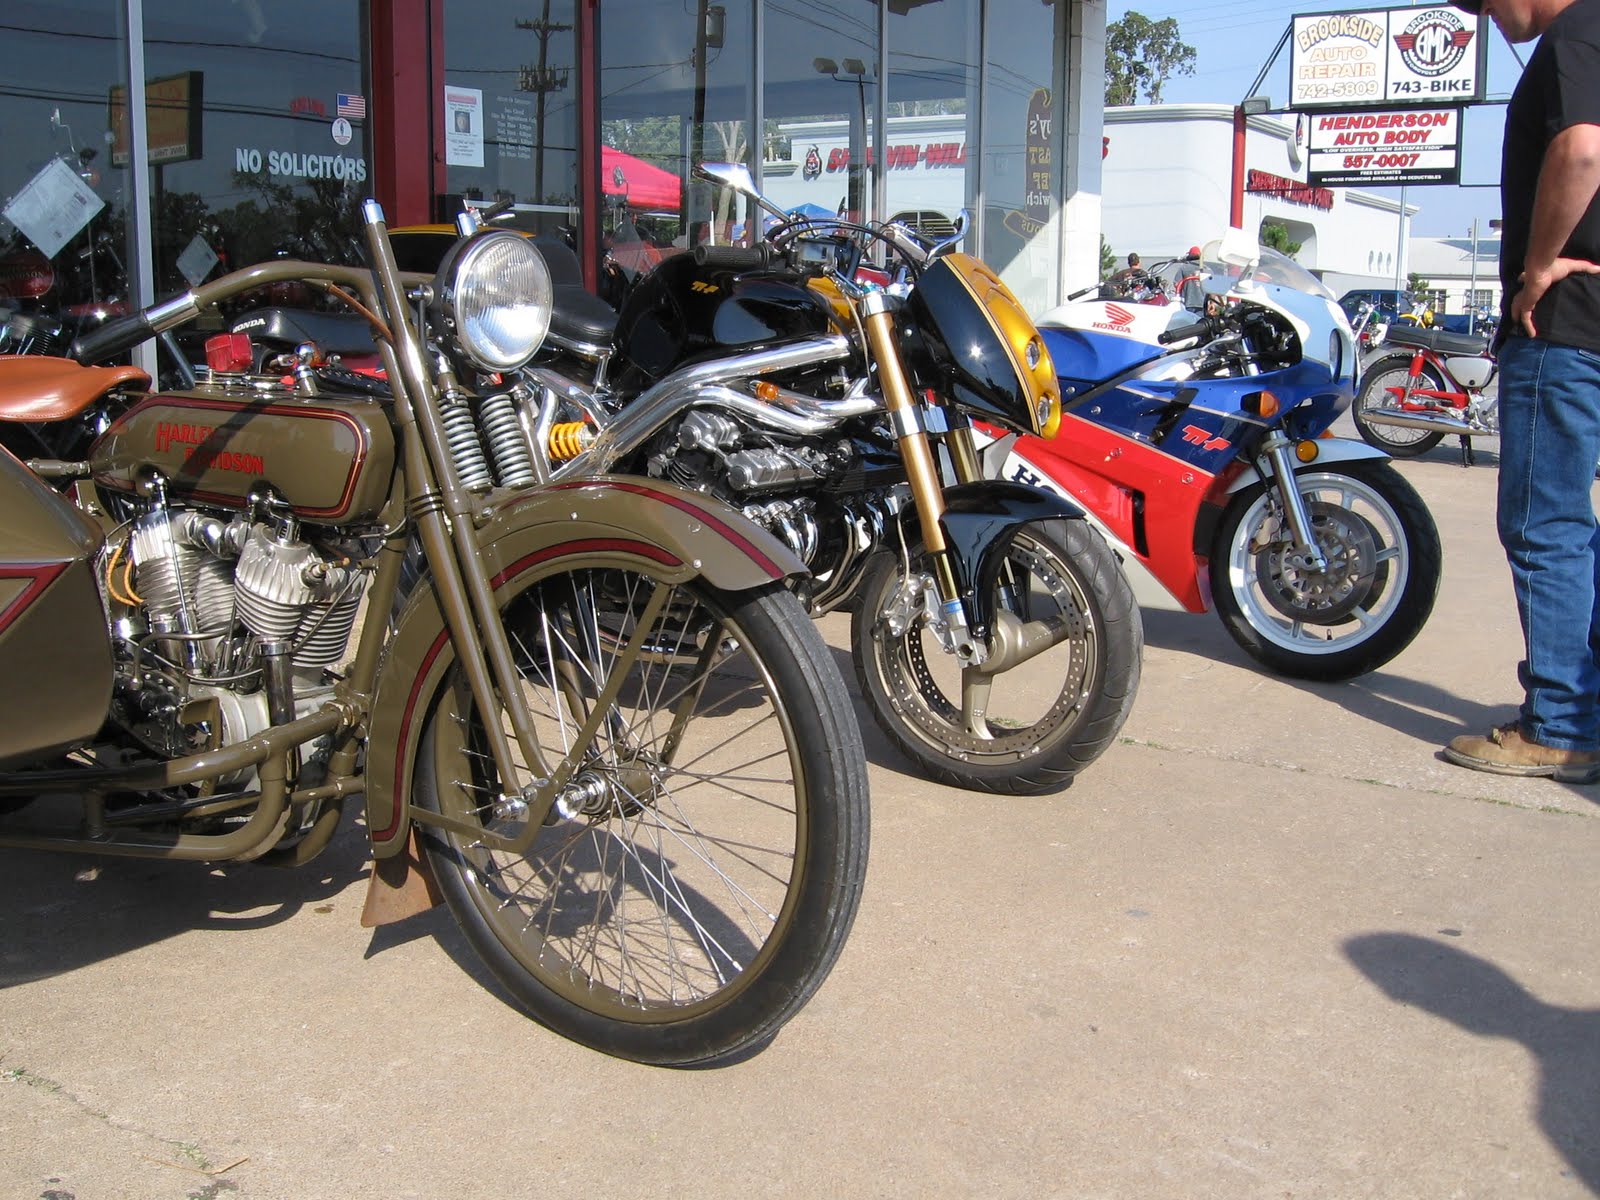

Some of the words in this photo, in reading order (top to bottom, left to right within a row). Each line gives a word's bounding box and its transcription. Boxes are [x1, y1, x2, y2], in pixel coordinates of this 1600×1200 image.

[1404, 10, 1464, 35] BROOKSIDE
[1297, 14, 1384, 53] BROOKSIDE
[1415, 26, 1453, 63] BMC
[1310, 45, 1368, 63] AUTO
[1299, 62, 1377, 80] REPAIR
[1297, 80, 1379, 99] 742-5809
[1392, 79, 1472, 94] 743-BIKE
[1319, 112, 1449, 130] HENDERSON
[1333, 131, 1380, 146] AUTO
[1383, 129, 1433, 144] BODY
[236, 147, 262, 174] NO
[268, 150, 367, 182] SOLICITORS
[1343, 153, 1421, 168] 557-0007
[1091, 321, 1132, 334] HONDA
